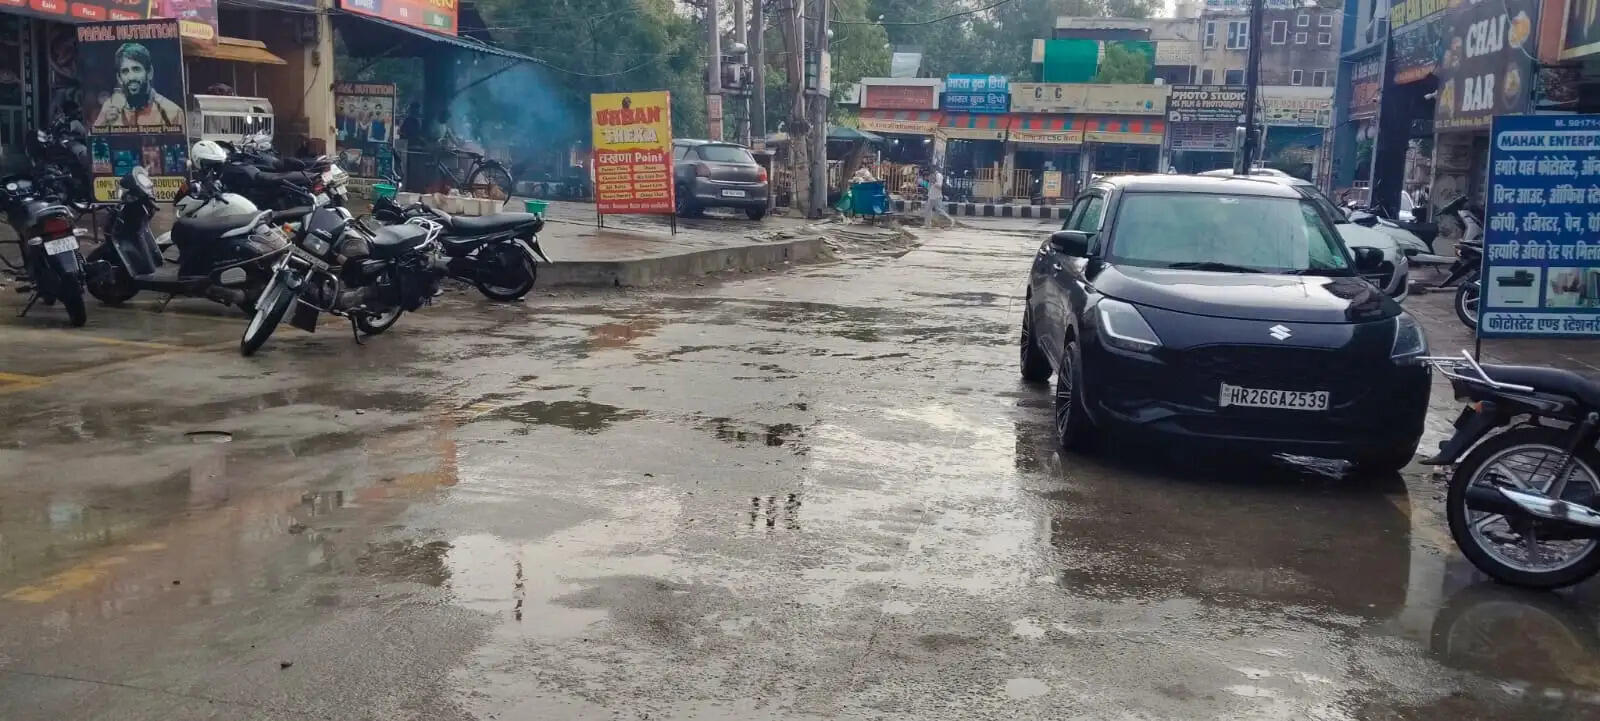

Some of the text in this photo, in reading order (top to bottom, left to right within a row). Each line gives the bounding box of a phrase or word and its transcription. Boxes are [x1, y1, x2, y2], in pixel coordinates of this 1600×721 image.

[116, 22, 178, 40] NUTRITION
[1466, 13, 1507, 58] CHAI
[1172, 92, 1208, 100] PHOTO
[1461, 74, 1496, 112] BAR
[597, 105, 660, 126] URBAN
[1502, 135, 1600, 147] MAHAK ENTERPR
[635, 151, 664, 163] Point
[1495, 155, 1517, 175] हमारे
[1488, 240, 1520, 261] इत्यादि
[1521, 240, 1546, 260] उचित
[1547, 240, 1560, 260] रेट
[1561, 244, 1575, 260] पर
[1489, 314, 1535, 330] फोटोस्टेट
[1537, 318, 1560, 330] एण्ड
[1231, 387, 1328, 409] HR26GA2539
